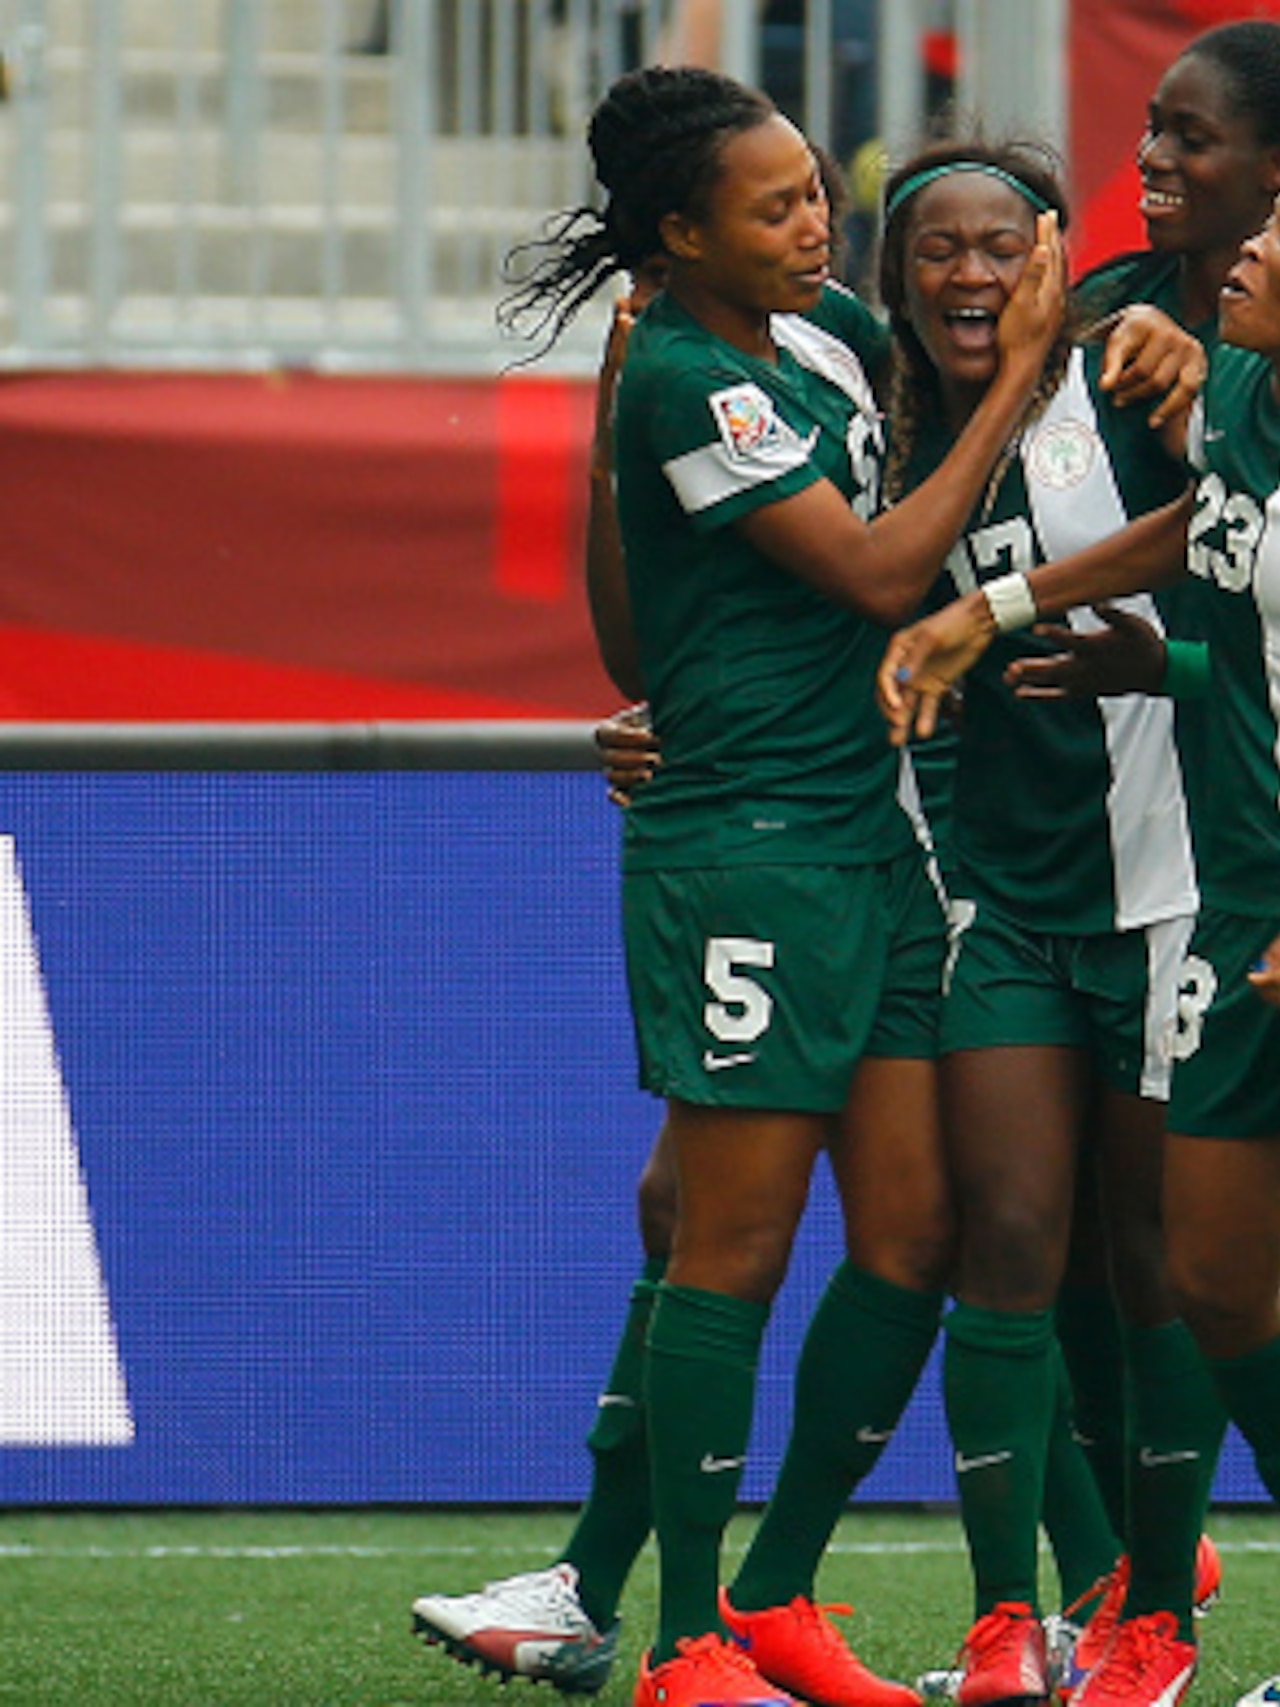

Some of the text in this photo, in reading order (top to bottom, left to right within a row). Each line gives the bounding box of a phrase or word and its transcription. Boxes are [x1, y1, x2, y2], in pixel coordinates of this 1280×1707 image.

[945, 515, 1036, 597] 17
[1187, 472, 1264, 593] 23
[704, 936, 774, 1042] 5
